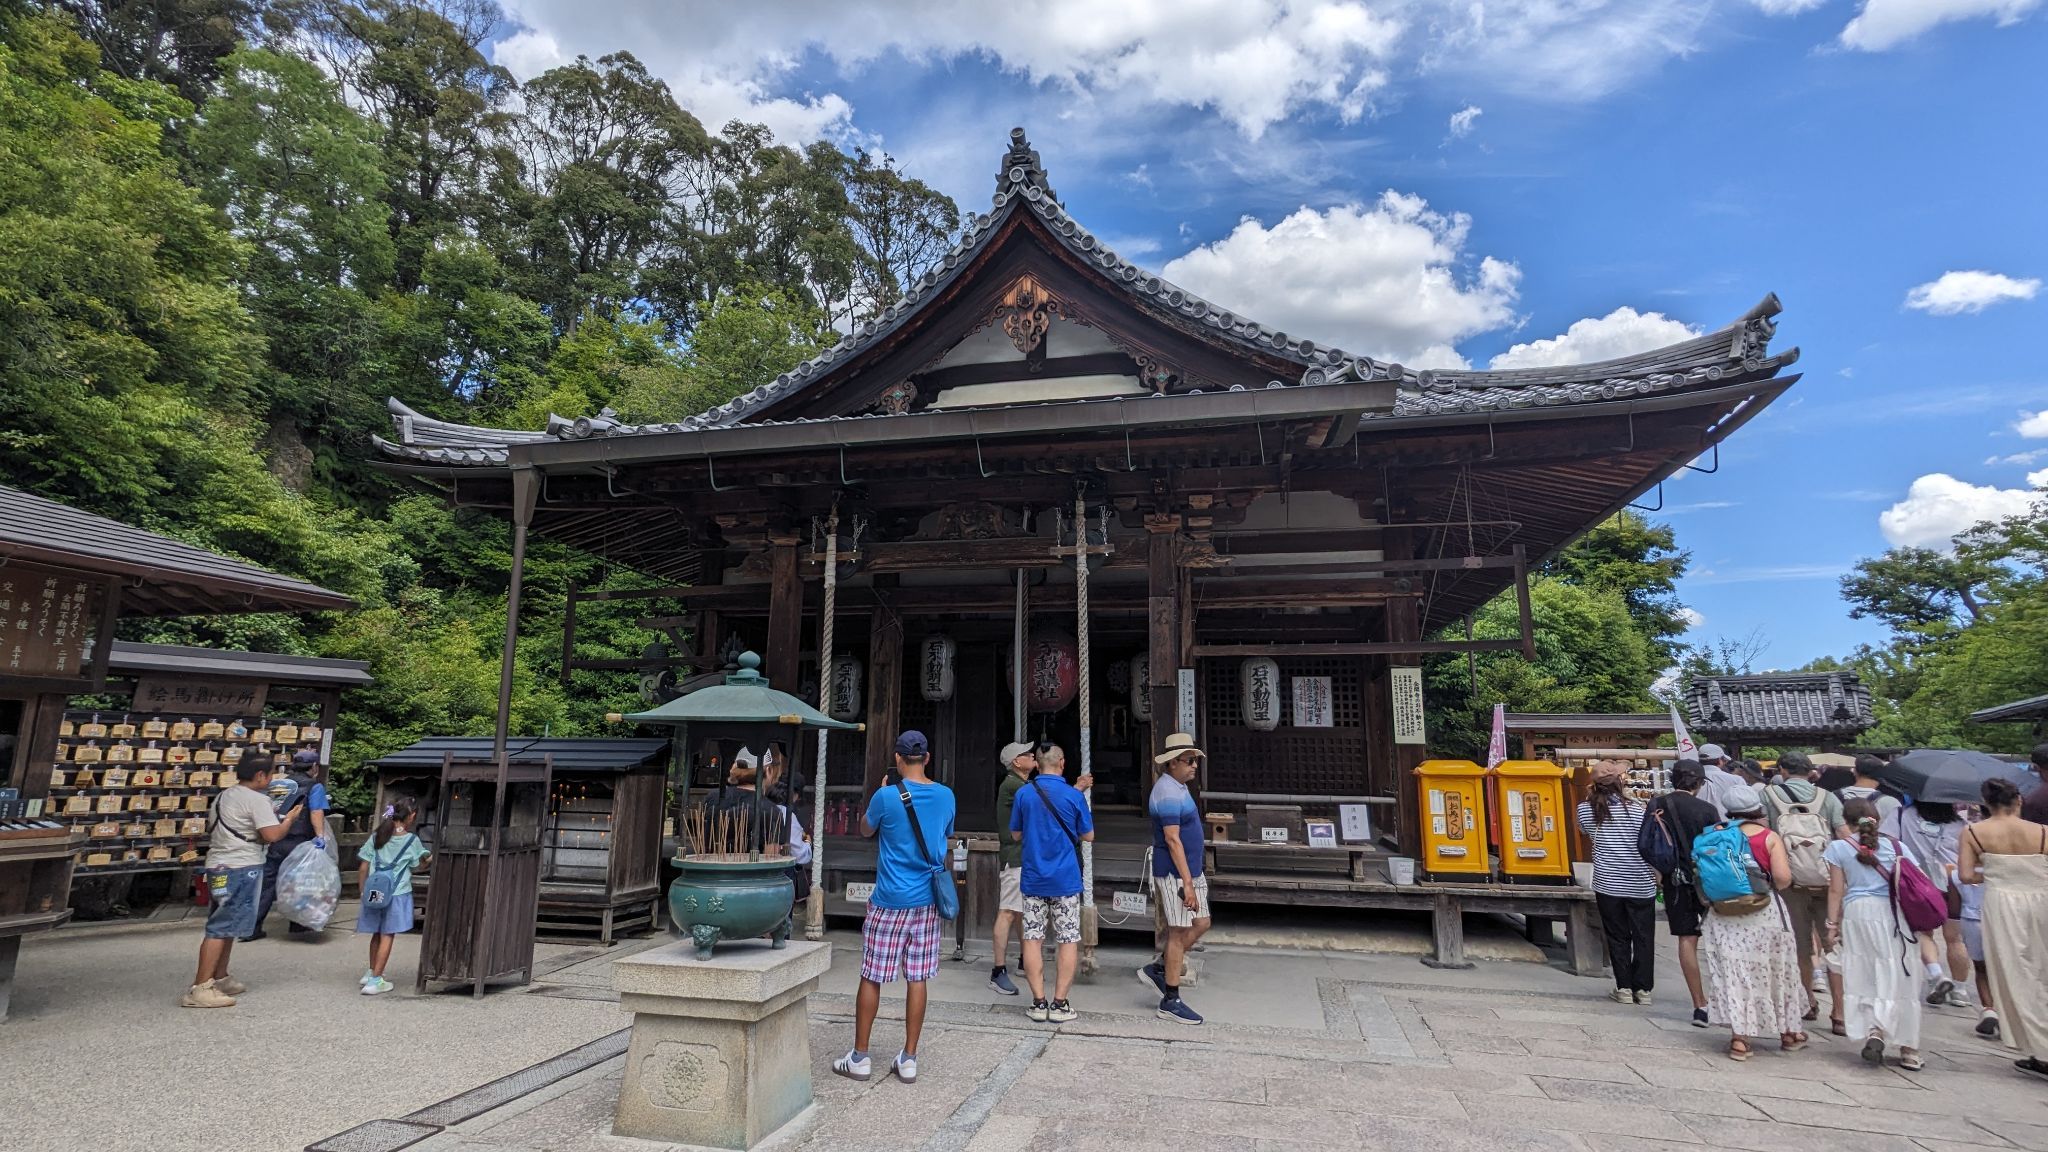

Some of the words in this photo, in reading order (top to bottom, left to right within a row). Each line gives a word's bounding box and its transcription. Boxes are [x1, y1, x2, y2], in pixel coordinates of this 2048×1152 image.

[1251, 665, 1271, 721] 石不動明王
